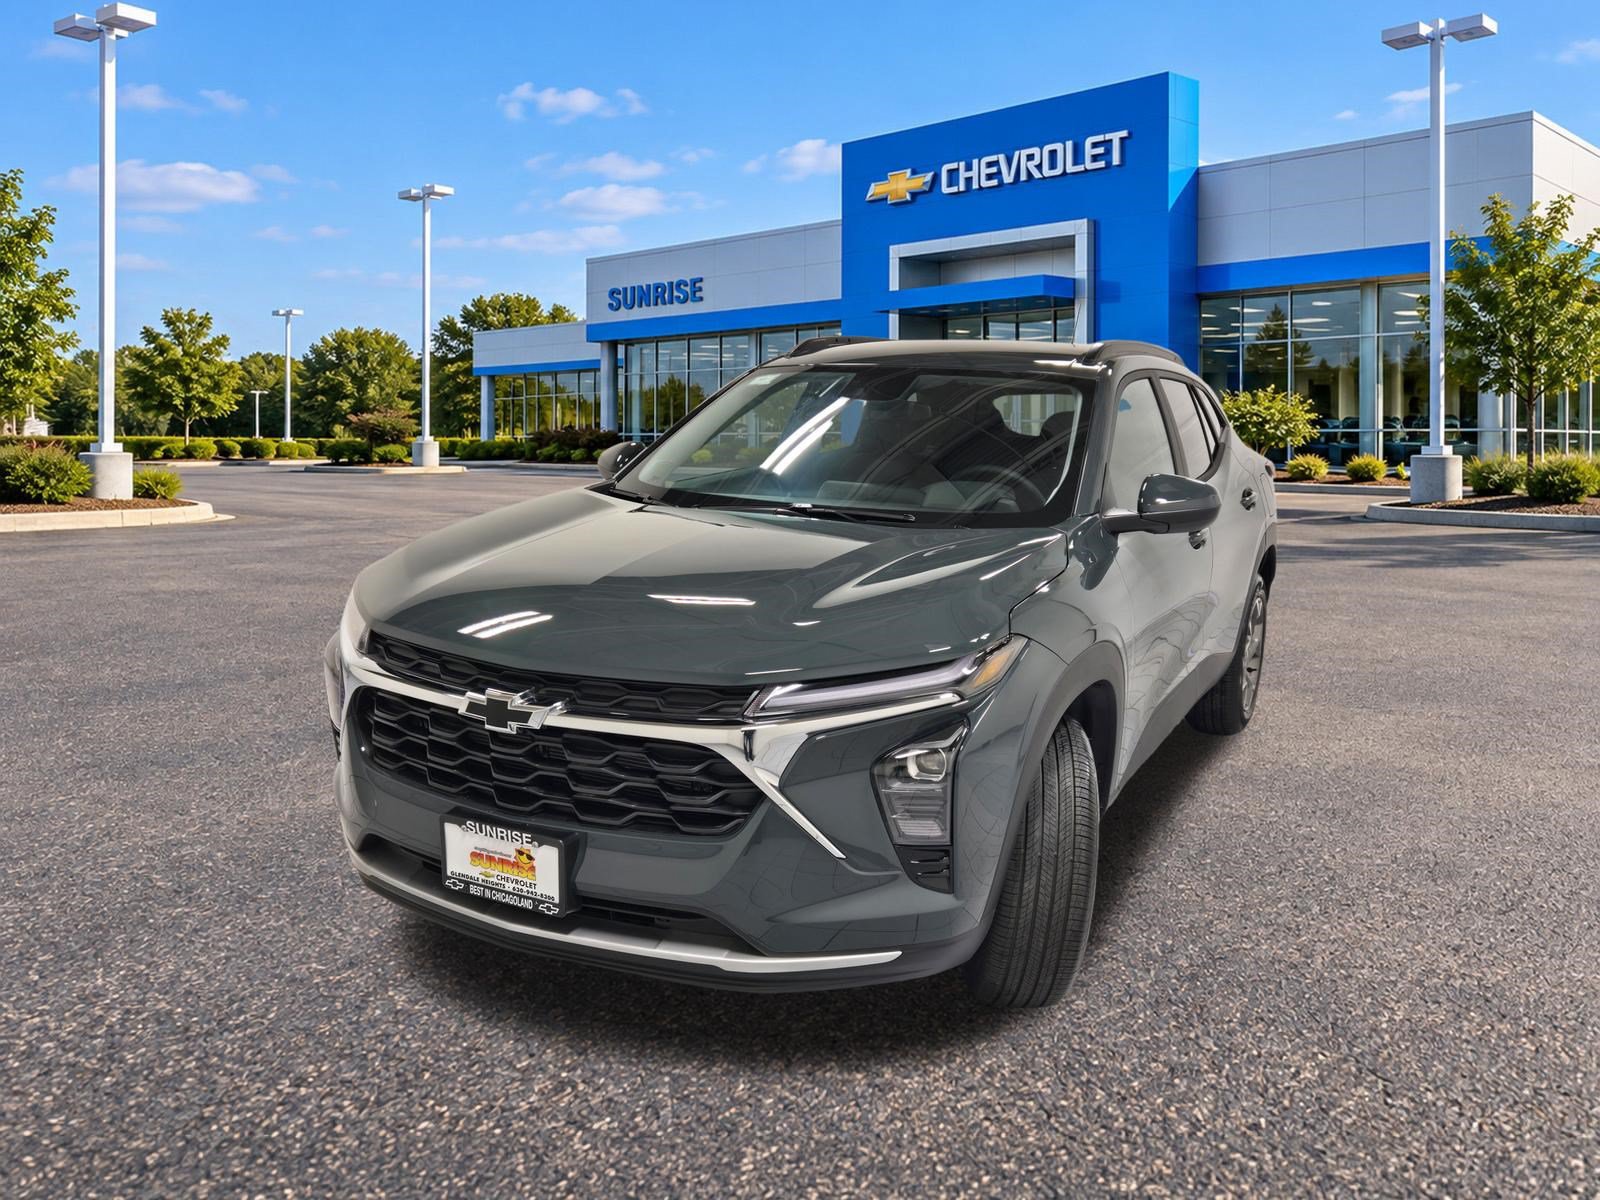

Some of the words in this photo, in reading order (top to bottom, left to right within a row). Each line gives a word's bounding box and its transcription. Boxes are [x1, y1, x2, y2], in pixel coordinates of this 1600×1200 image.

[941, 130, 1129, 194] CHEVROLET
[608, 277, 704, 312] SUNRISE
[466, 820, 532, 846] SUNRISE
[470, 851, 536, 881] SUNRISE
[450, 870, 480, 882] GLENDALE
[481, 878, 506, 889] HEIGHTS
[496, 874, 537, 890] CHEVROLET
[469, 884, 484, 896] BEST
[484, 888, 491, 899] IN
[491, 890, 534, 910] CHICAGOLAND
